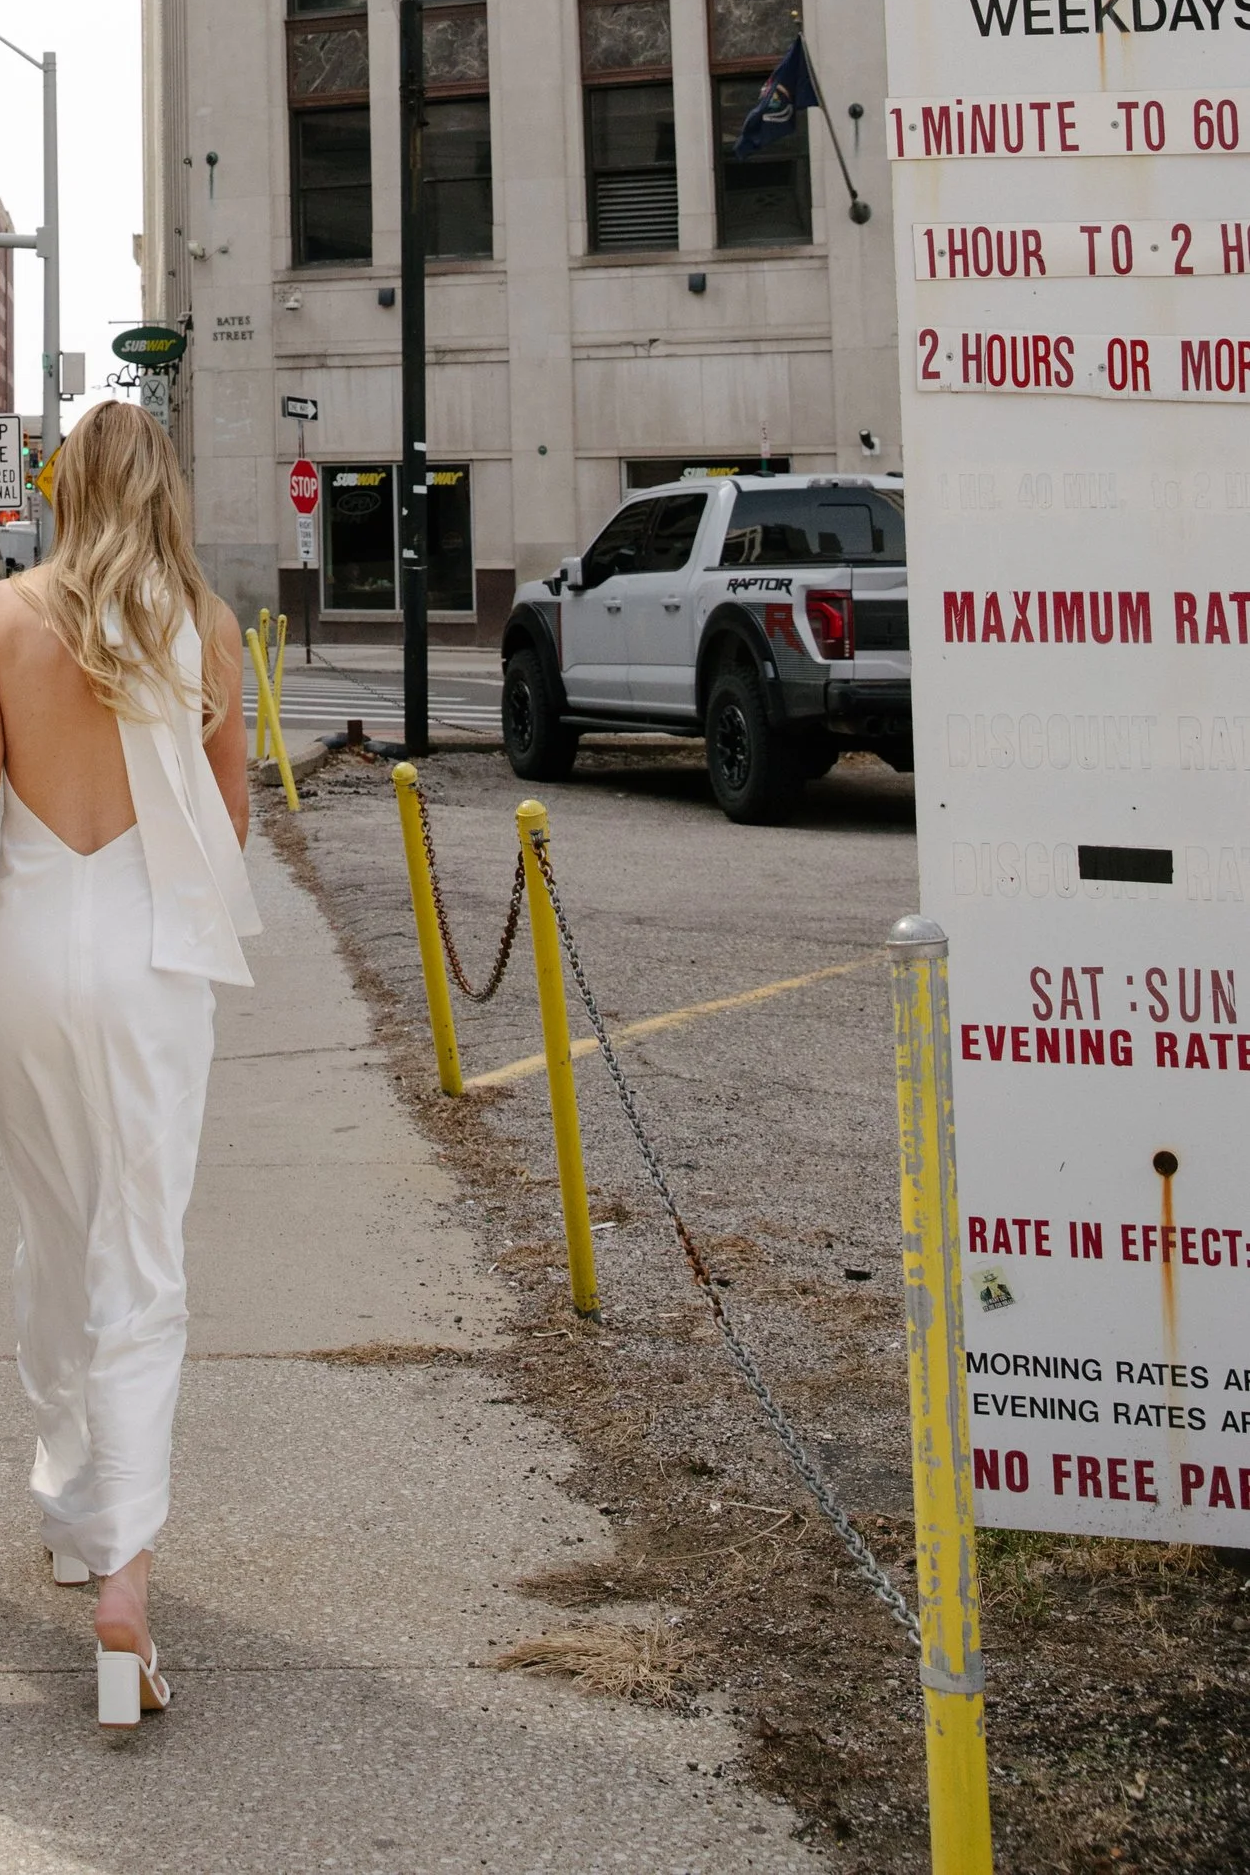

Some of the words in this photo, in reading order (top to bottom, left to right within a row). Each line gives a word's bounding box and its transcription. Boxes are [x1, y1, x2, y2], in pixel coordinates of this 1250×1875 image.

[890, 107, 905, 157] 1
[1117, 100, 1166, 152] TO
[1193, 98, 1239, 151] 60
[922, 228, 938, 278] 1
[948, 225, 1047, 278] HOUR
[1079, 224, 1134, 276] TO
[1171, 223, 1194, 274] 2
[1220, 223, 1250, 273] H
[213, 330, 254, 341] STREET
[217, 315, 250, 326] BATES
[121, 339, 177, 352] SUBWAY
[919, 329, 941, 380] 2
[961, 332, 1075, 388] HOURS
[1107, 337, 1150, 392] OR
[291, 475, 318, 498] STOP
[333, 472, 387, 486] SUBWAY
[425, 472, 464, 486] BWAY
[726, 578, 793, 597] RAPTOR
[943, 590, 1153, 644] MAXIMUM
[1173, 591, 1250, 644] RAT
[1030, 966, 1104, 1021] SAT
[960, 1024, 1133, 1067] EVENING
[1155, 1031, 1250, 1072] RATE
[968, 1216, 1052, 1258] RATE
[1069, 1220, 1103, 1260] IN
[966, 1351, 1102, 1383] MORNING
[1116, 1361, 1209, 1390] RATES
[972, 1393, 1100, 1424] EVENING
[1113, 1402, 1207, 1431] RATES
[973, 1447, 1029, 1494] NO
[1052, 1453, 1157, 1503] FREE
